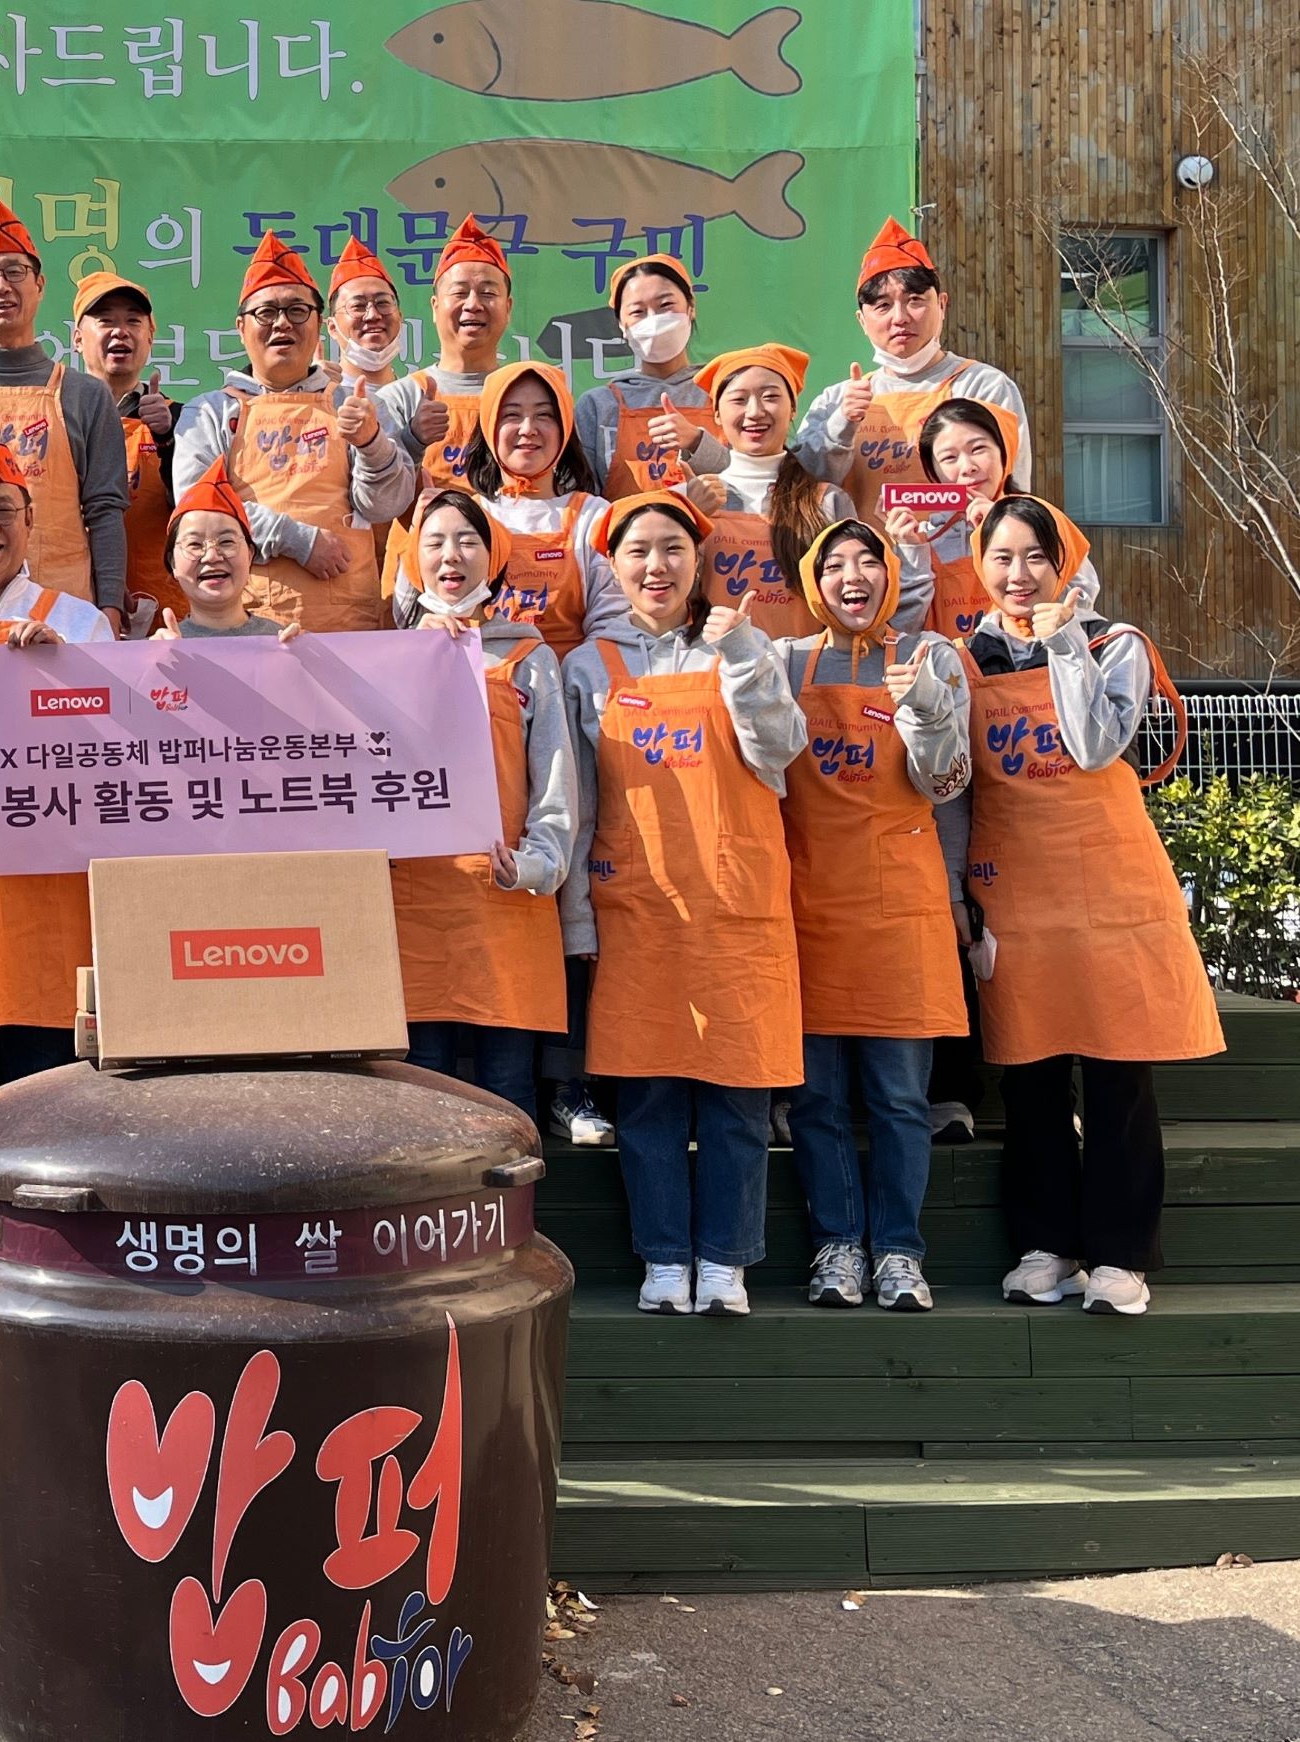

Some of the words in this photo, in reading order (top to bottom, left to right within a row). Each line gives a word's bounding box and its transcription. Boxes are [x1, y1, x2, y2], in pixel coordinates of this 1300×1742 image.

[561, 213, 709, 295] 구민
[25, 421, 47, 436] Lenovo
[303, 429, 327, 440] Lenovo
[890, 489, 961, 504] Lenovo
[37, 695, 104, 710] Lenovo
[151, 685, 188, 711] 밥퍼
[985, 708, 1010, 719] DAIL
[1011, 702, 1055, 715] Communi
[863, 706, 890, 722] Lenovo
[0, 748, 19, 770] X
[26, 738, 149, 771] 다일공동체
[158, 732, 358, 765] 밥퍼나눔운동본부
[632, 720, 703, 766] 밥퍼
[811, 736, 875, 776] 밥퍼
[987, 717, 1068, 776] 밥퍼
[837, 769, 875, 783] Babfor
[1026, 758, 1075, 780] Babfor
[1, 781, 81, 827] 봉사
[93, 778, 175, 825] 활동
[188, 777, 225, 821] 및
[238, 772, 358, 817] 노트북
[370, 767, 452, 813] 후원
[183, 941, 309, 968] Lenovo
[116, 1220, 258, 1277] 생명의
[295, 1220, 343, 1275] 쌀
[372, 1194, 506, 1267] 이어가기
[106, 1310, 463, 1717] 밥퍼
